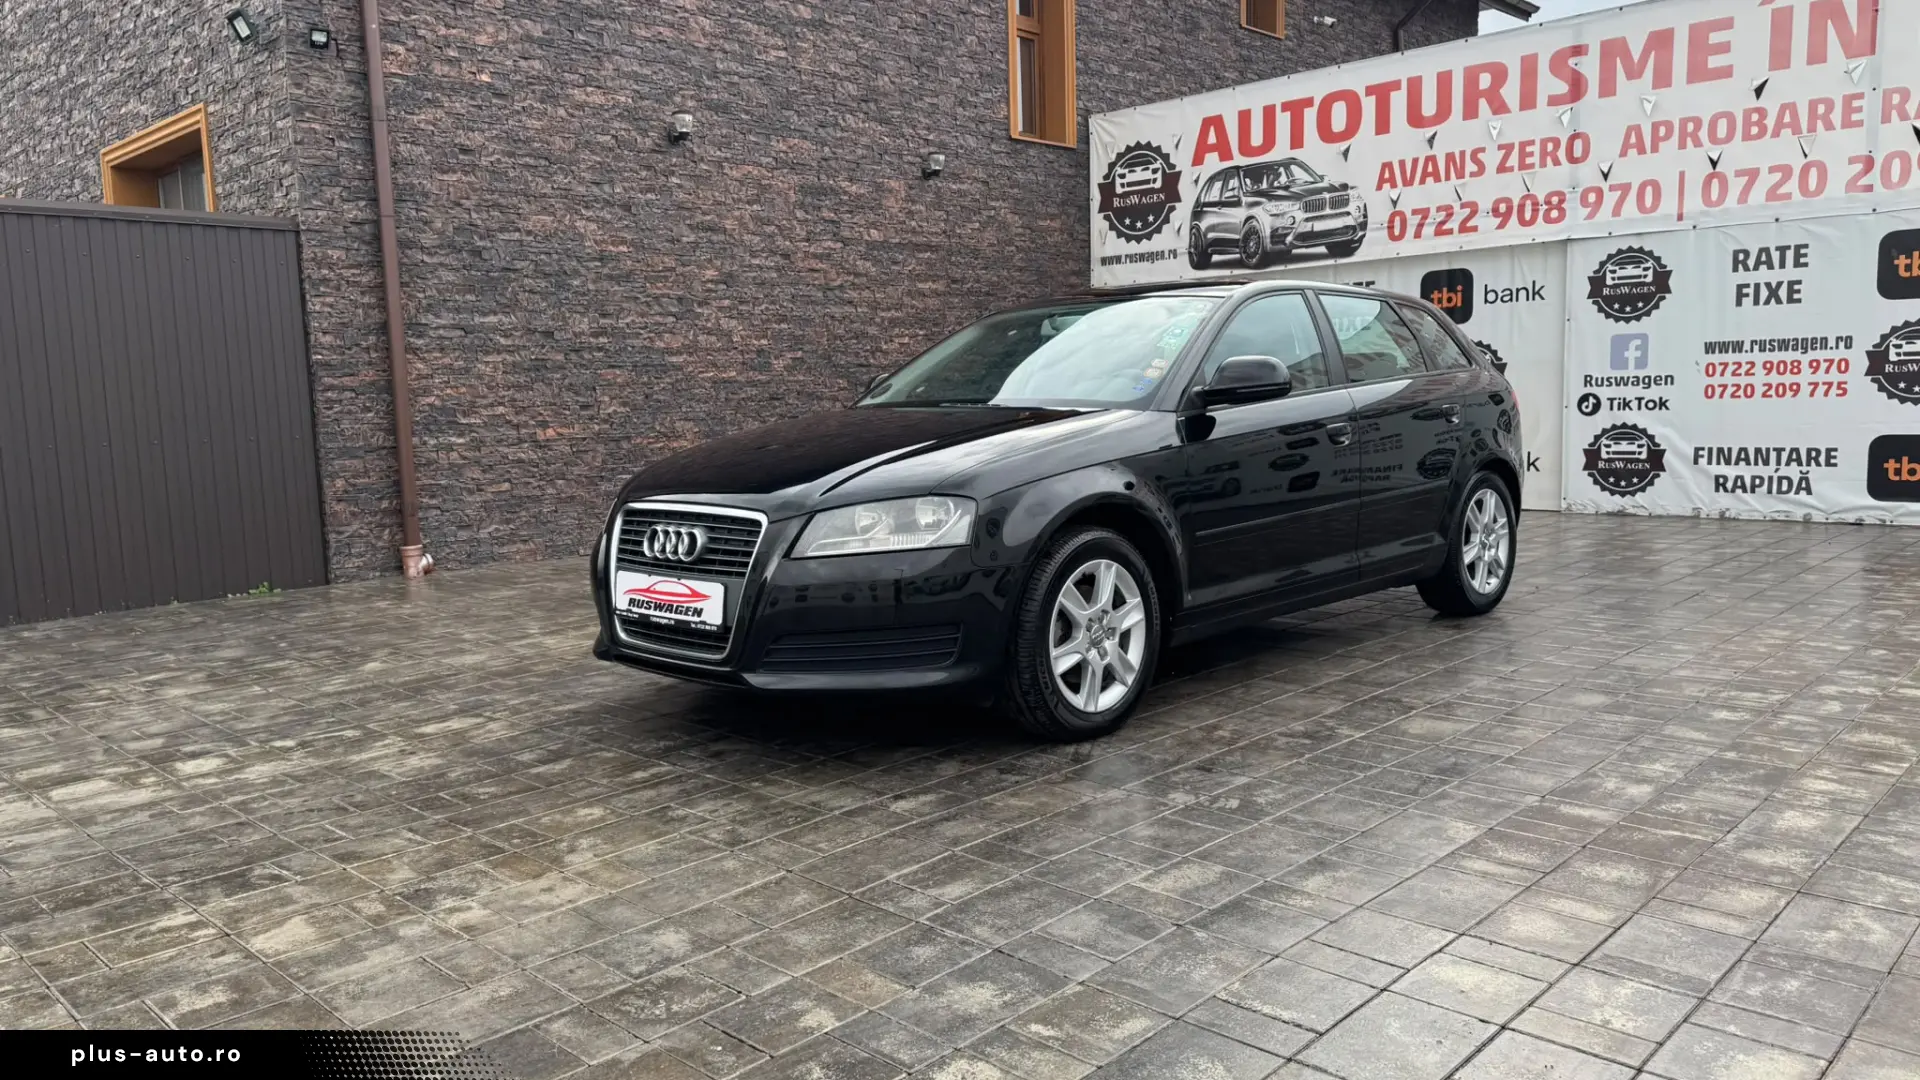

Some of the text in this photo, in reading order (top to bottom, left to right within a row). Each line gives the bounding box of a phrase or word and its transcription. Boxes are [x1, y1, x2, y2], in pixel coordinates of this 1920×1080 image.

[1191, 16, 1735, 167] AUTOTURISME
[1376, 86, 1920, 191] AVANS ZERO APROBARE R
[1387, 200, 1480, 242] 0722
[1490, 190, 1567, 231] 908
[1579, 178, 1662, 221] 970
[1701, 159, 1828, 207] 0720
[1845, 150, 1920, 194] 20
[1100, 248, 1178, 267] www.ruswagen.ro
[1732, 244, 1809, 273] RATE
[1431, 280, 1546, 308] tbi bank
[1735, 280, 1803, 307] FIXE
[1704, 335, 1853, 355] www.ruswagen.ro
[1704, 358, 1850, 378] 0722 908 970
[1583, 374, 1675, 390] Ruswagen
[1704, 380, 1848, 400] 0720 209 775
[1606, 396, 1670, 412] TikTok
[628, 597, 704, 618] RUSWAGEN
